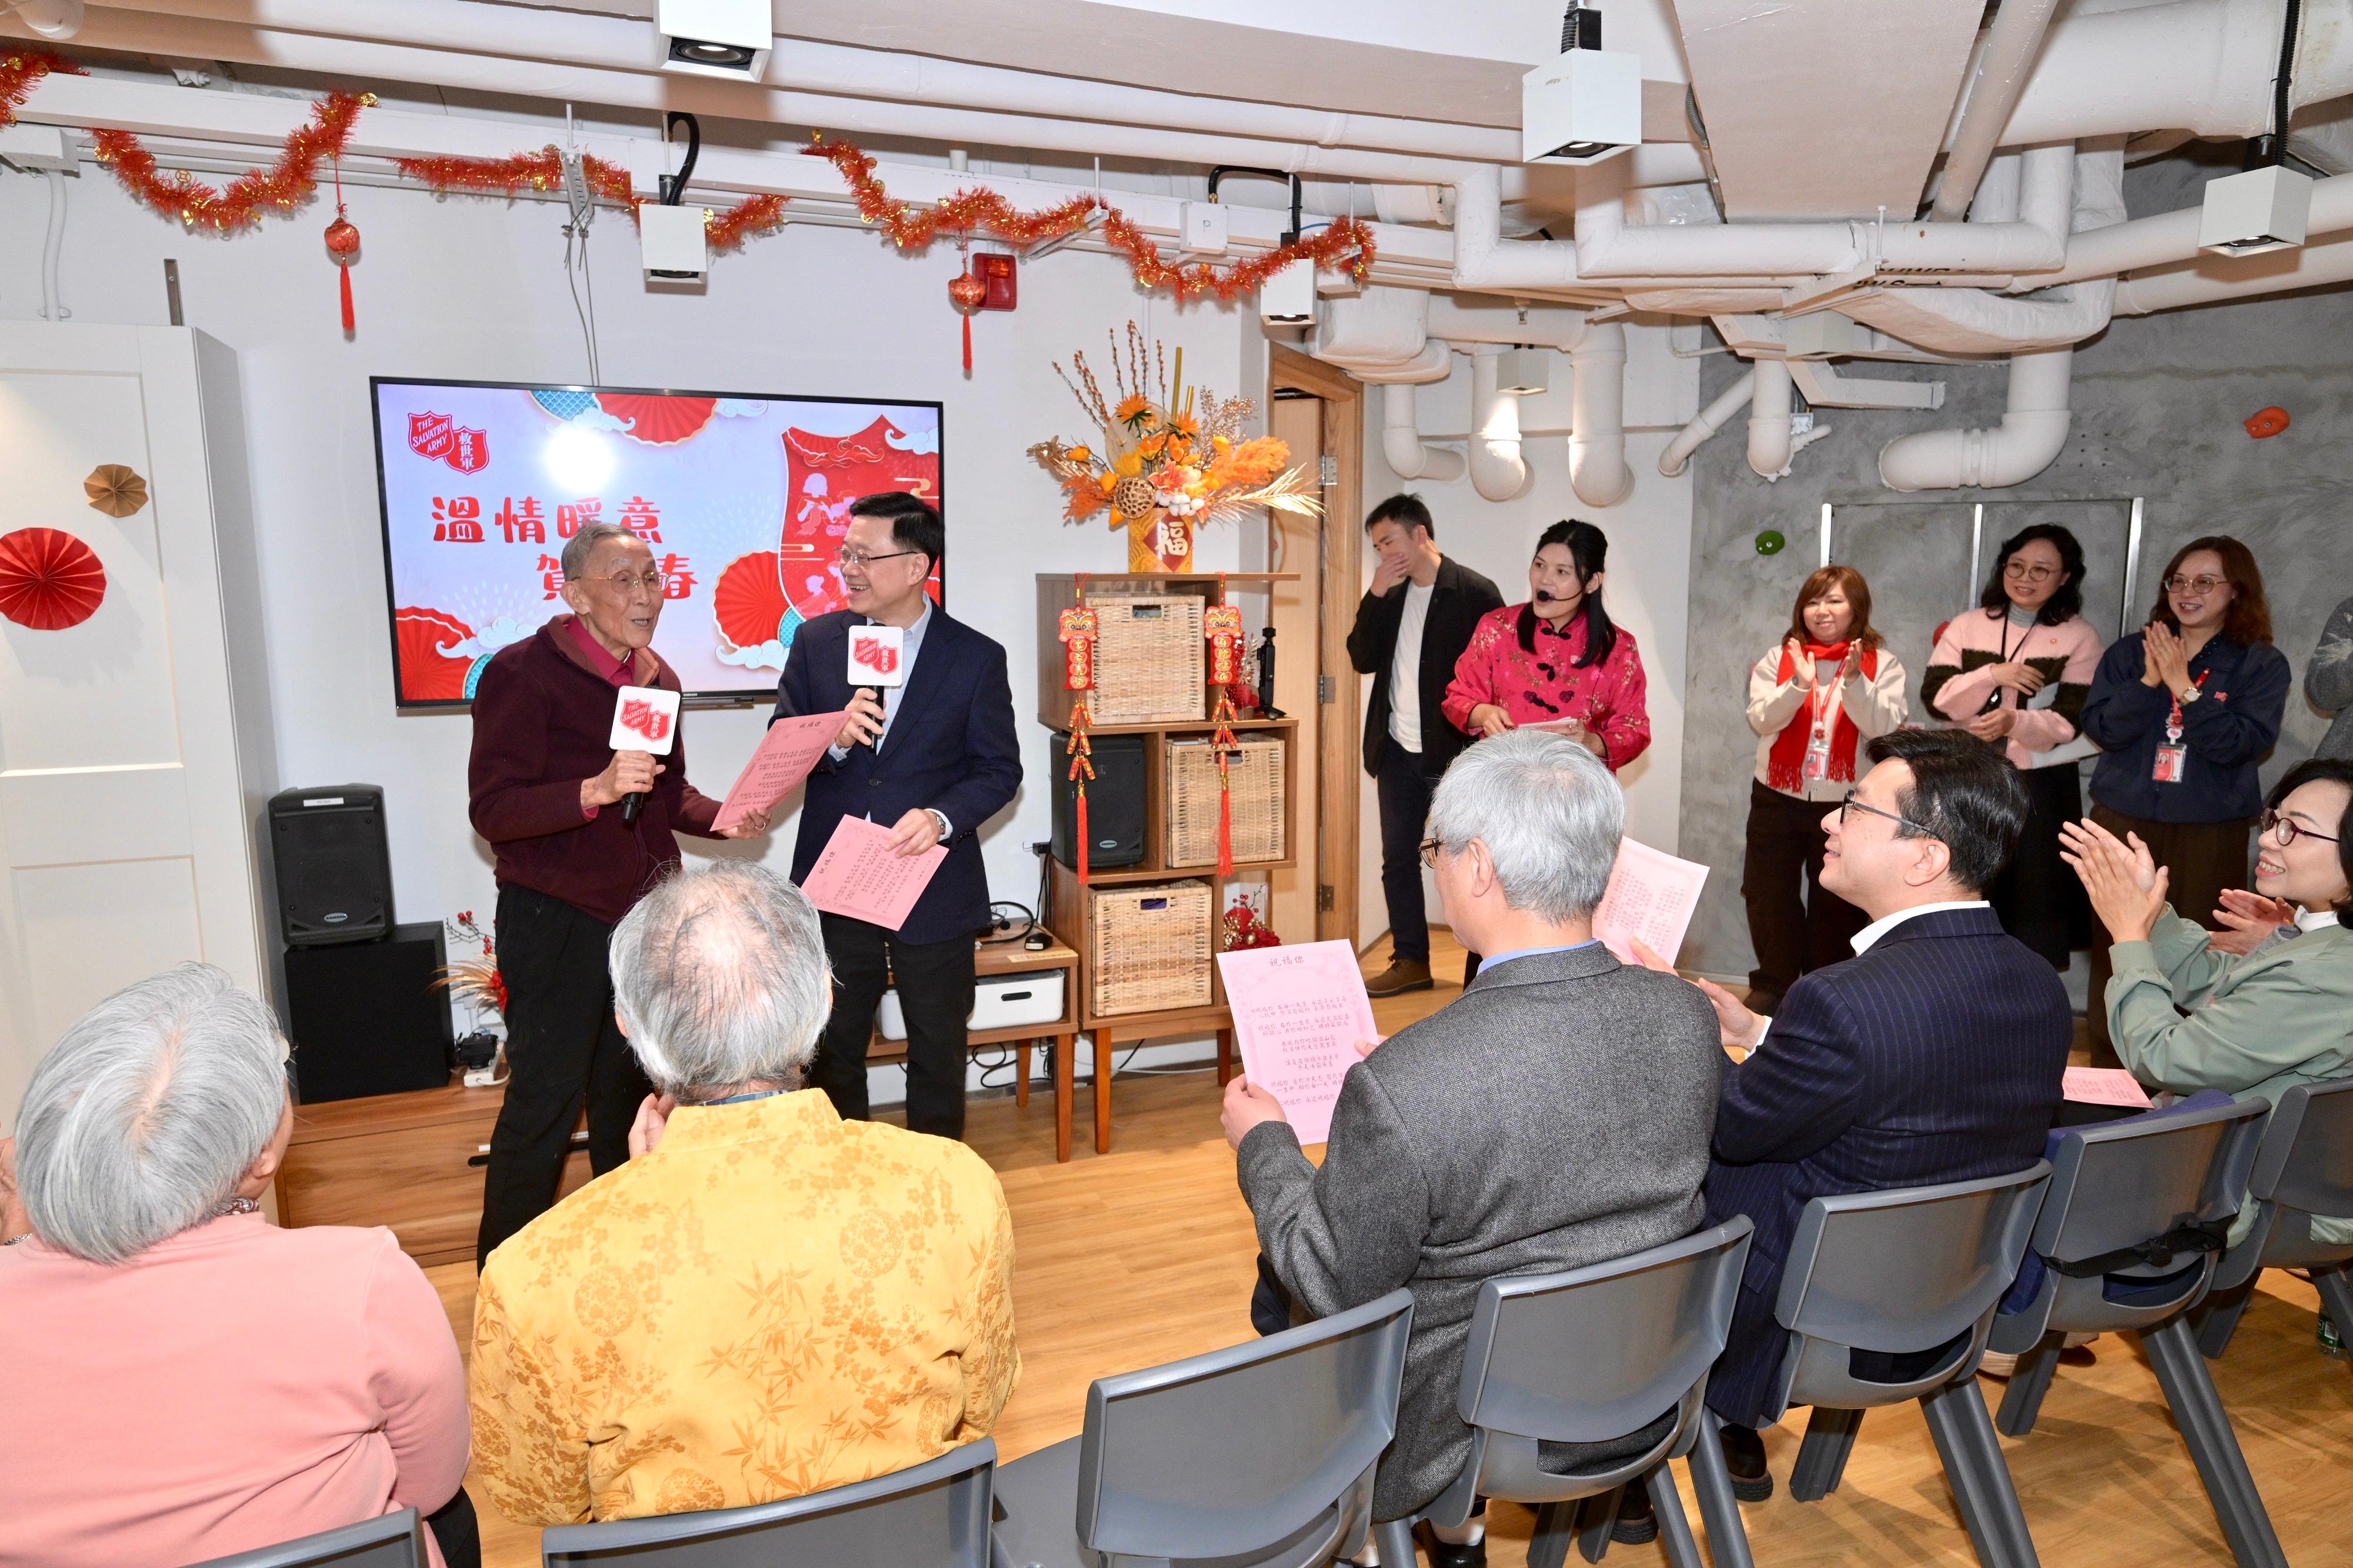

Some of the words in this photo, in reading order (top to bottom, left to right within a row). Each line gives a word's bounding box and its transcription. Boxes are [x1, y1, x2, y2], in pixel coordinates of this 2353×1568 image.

[417, 417, 434, 432] THE
[413, 419, 448, 447] SALVATION
[427, 433, 447, 453] ARMY
[1154, 522, 1188, 556] 福
[863, 652, 876, 662] ARMY
[622, 705, 648, 722] SALVATION
[628, 703, 639, 711] THE
[631, 715, 646, 726] ARMY
[1269, 955, 1305, 967] 祝福你
